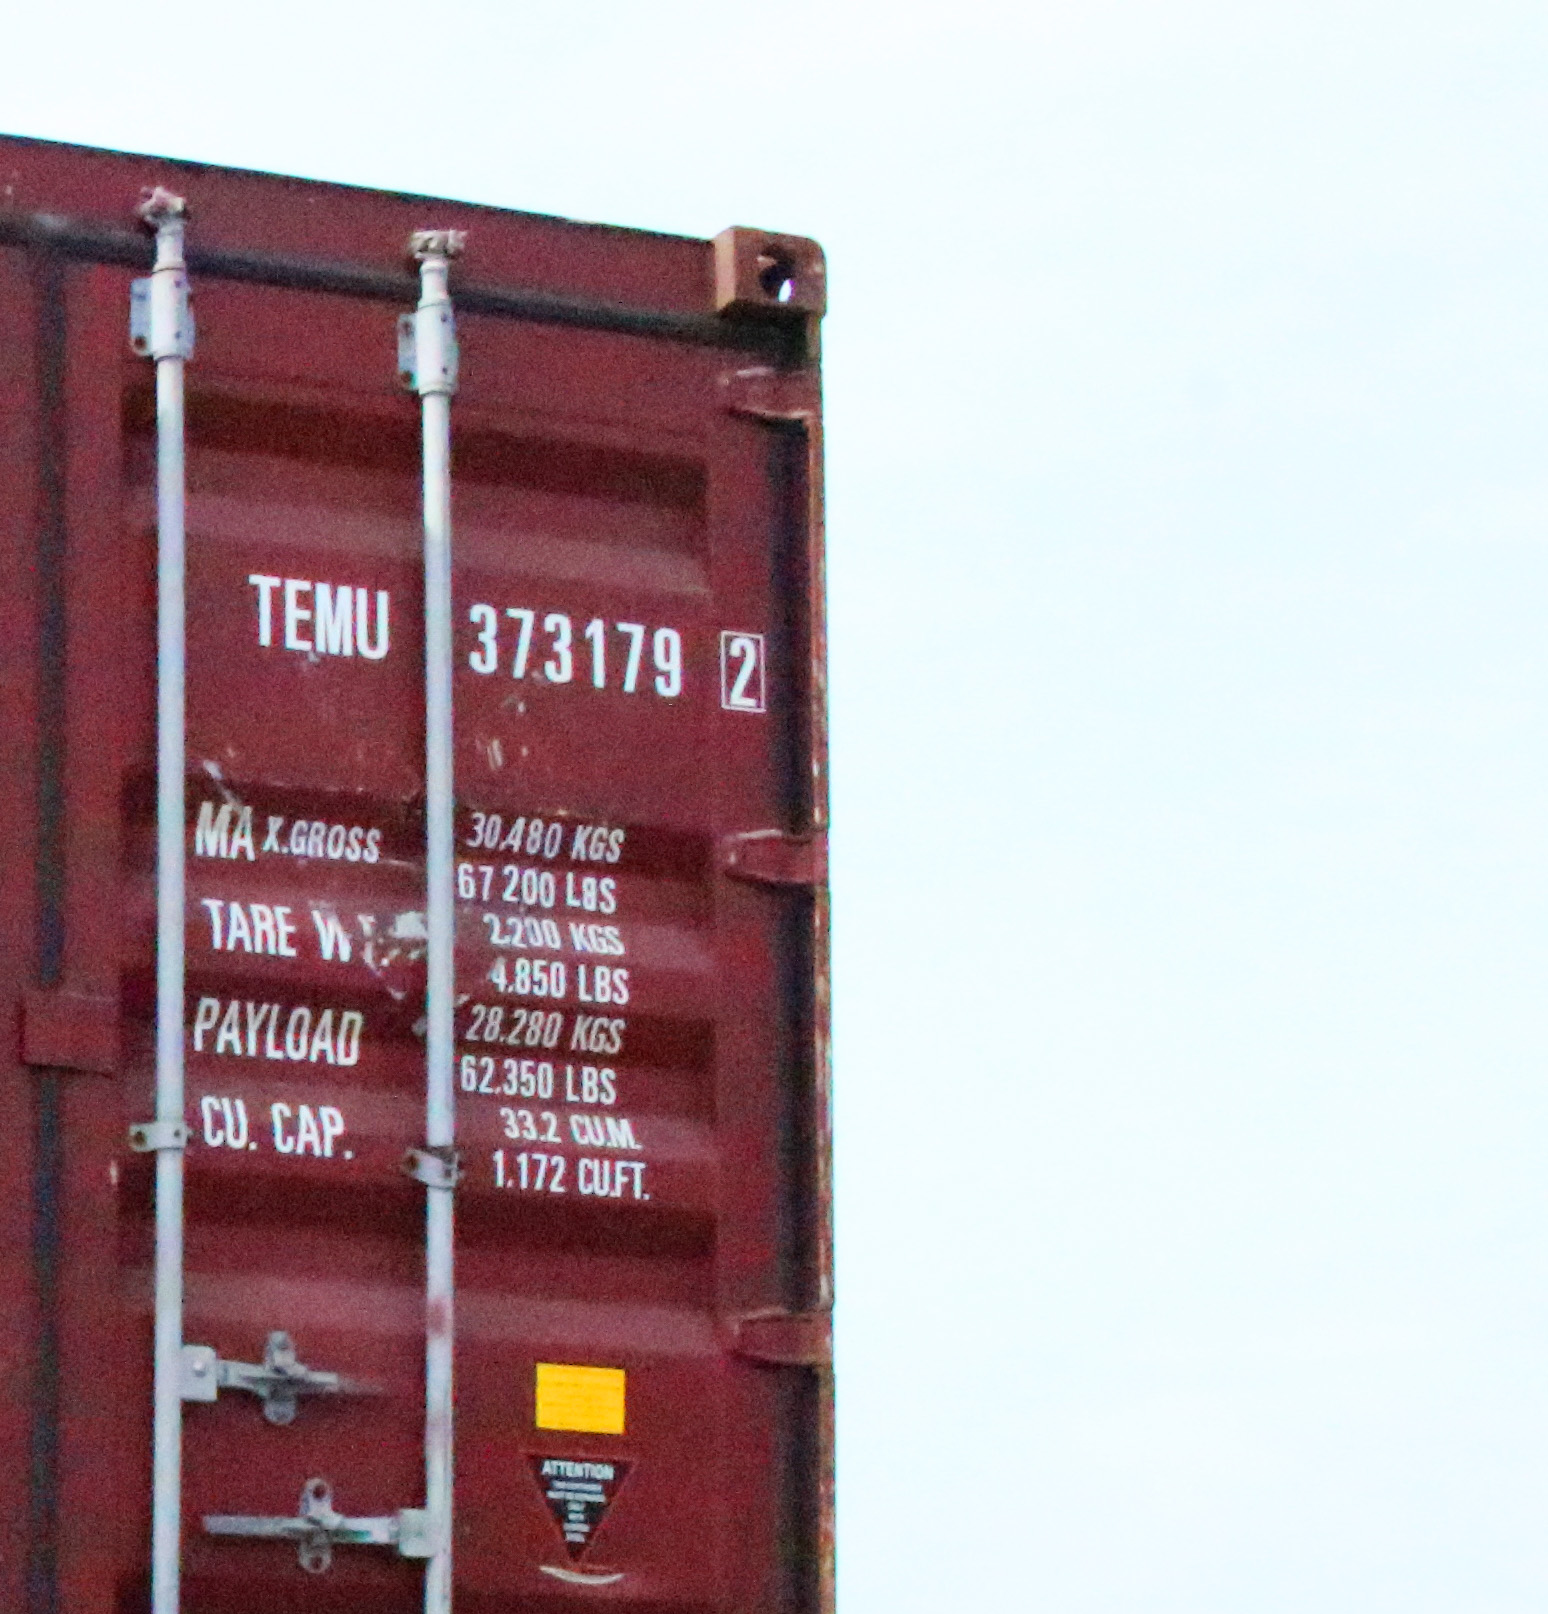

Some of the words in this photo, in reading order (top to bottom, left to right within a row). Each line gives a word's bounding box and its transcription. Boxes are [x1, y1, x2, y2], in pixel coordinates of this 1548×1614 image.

[248, 573, 390, 661] TEMU
[466, 603, 683, 700] 373179
[726, 636, 760, 709] 2
[262, 814, 381, 864] X.GROSS
[569, 824, 625, 864] KGS
[565, 871, 617, 915] LBS
[201, 897, 298, 958] TARE
[568, 921, 626, 956] KGS
[577, 963, 631, 1005] LBS
[192, 996, 365, 1067] PAYLOAD
[465, 1003, 565, 1049] 28.280
[570, 1014, 627, 1056] KGS
[460, 1054, 554, 1100] 62.350
[564, 1064, 618, 1106] LBS
[200, 1095, 258, 1151] CU.
[269, 1102, 355, 1161] CAP.
[499, 1106, 562, 1144] 33.2
[493, 1149, 567, 1193] 1.172
[541, 1460, 614, 1480] ATTENTION
